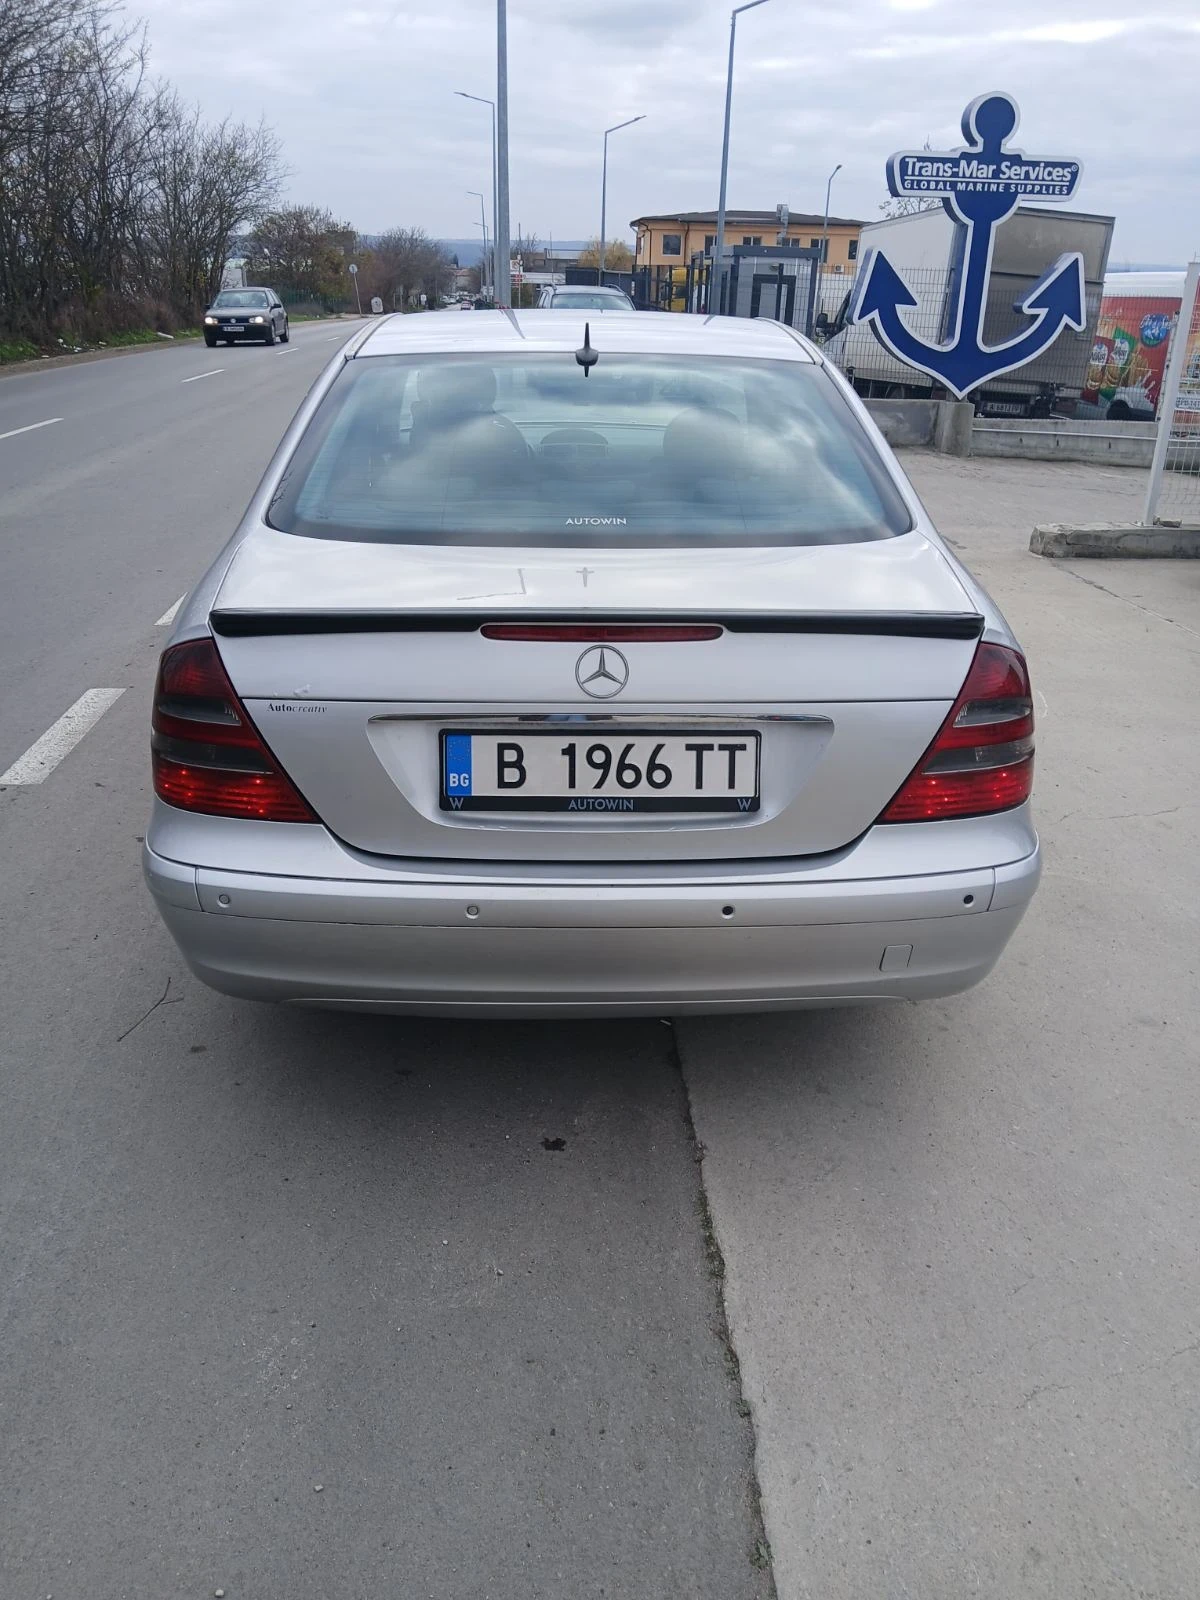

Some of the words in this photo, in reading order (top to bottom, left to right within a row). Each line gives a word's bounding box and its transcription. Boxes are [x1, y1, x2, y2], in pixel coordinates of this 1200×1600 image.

[905, 157, 996, 179] Trans-Mar
[904, 180, 952, 190] GLOBAL
[957, 182, 1005, 192] MARINE
[1010, 184, 1068, 194] SUPPLIES
[566, 517, 627, 525] AUTOWIN
[497, 743, 527, 789] B
[561, 743, 672, 789] 1966
[685, 743, 747, 790] TT
[449, 773, 470, 787] BG
[449, 798, 464, 809] W
[568, 799, 634, 811] AUTOWIN
[737, 799, 751, 810] W
